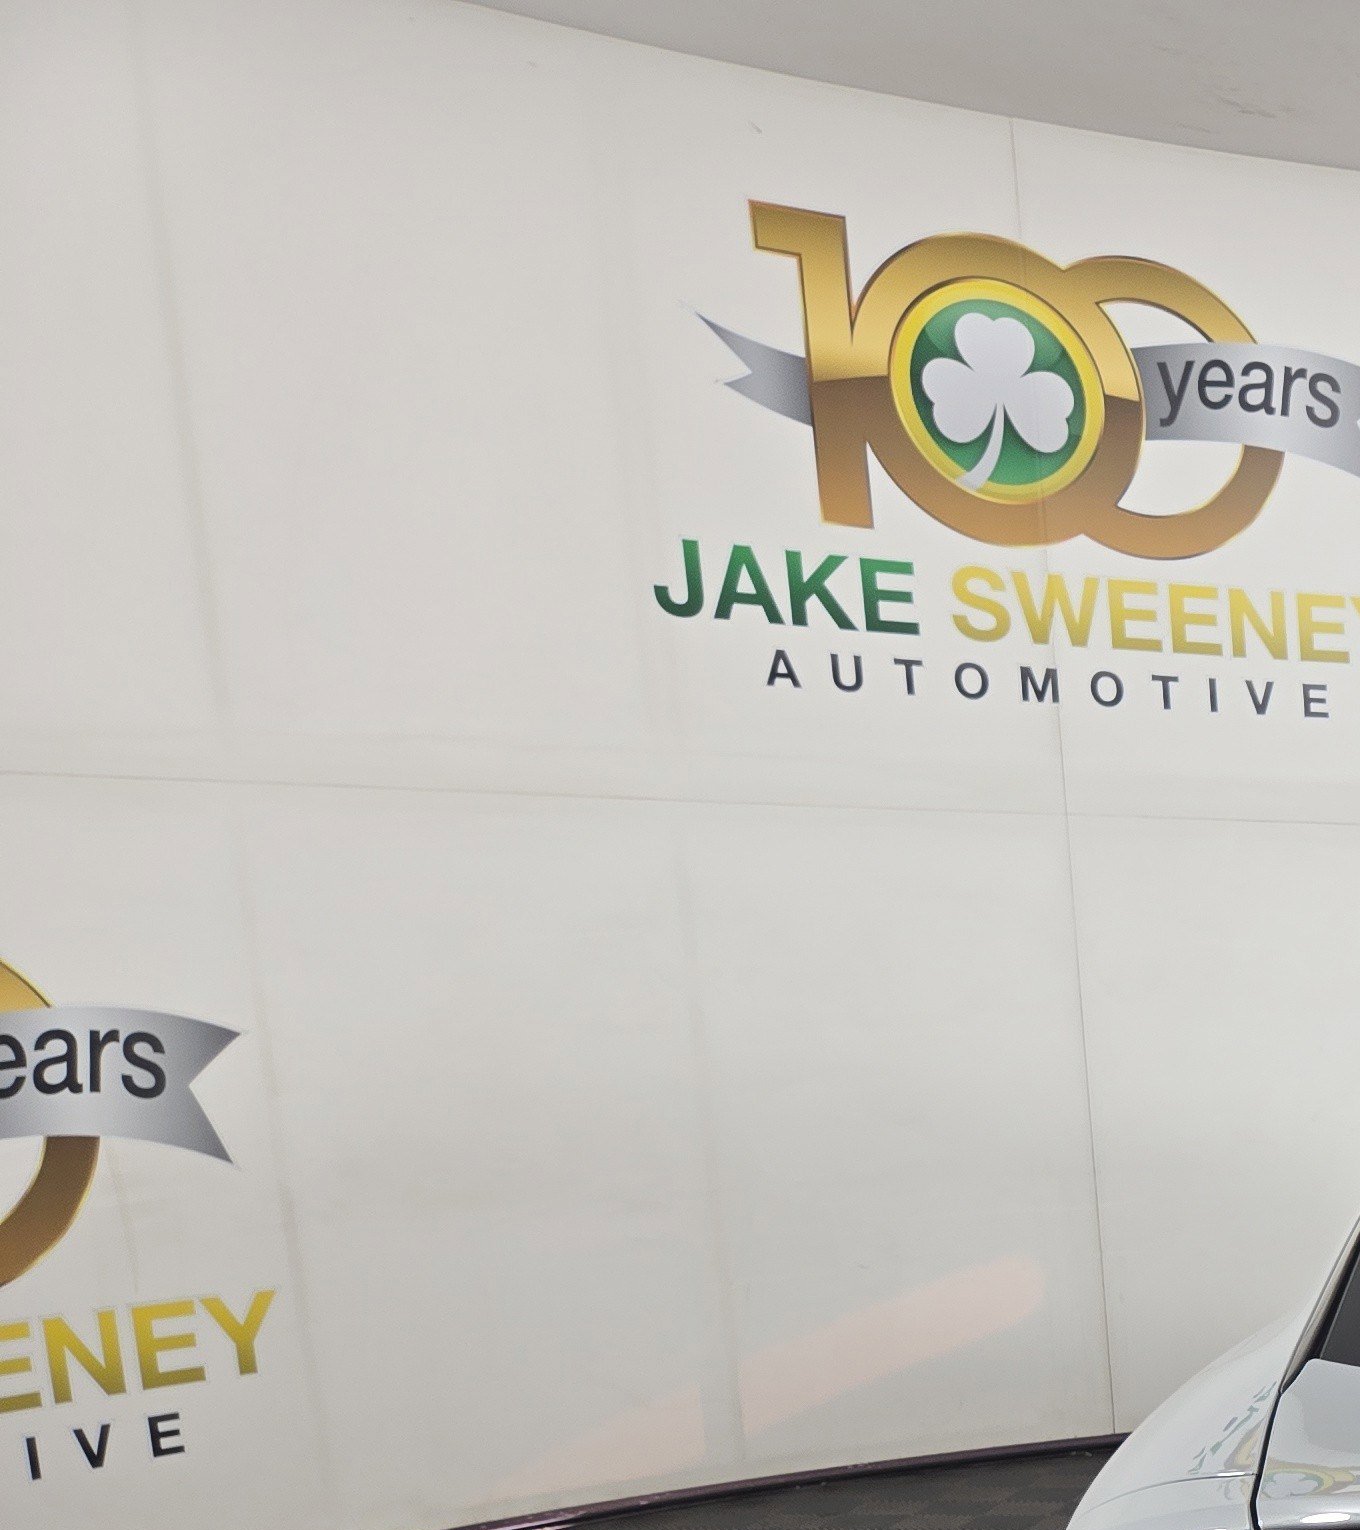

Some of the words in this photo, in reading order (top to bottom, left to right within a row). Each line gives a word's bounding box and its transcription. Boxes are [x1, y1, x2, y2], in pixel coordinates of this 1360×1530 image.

[748, 199, 1286, 559] 100
[1157, 357, 1342, 429] years
[653, 539, 920, 635] JAKE
[766, 649, 1330, 718] AUTOMOTIVE
